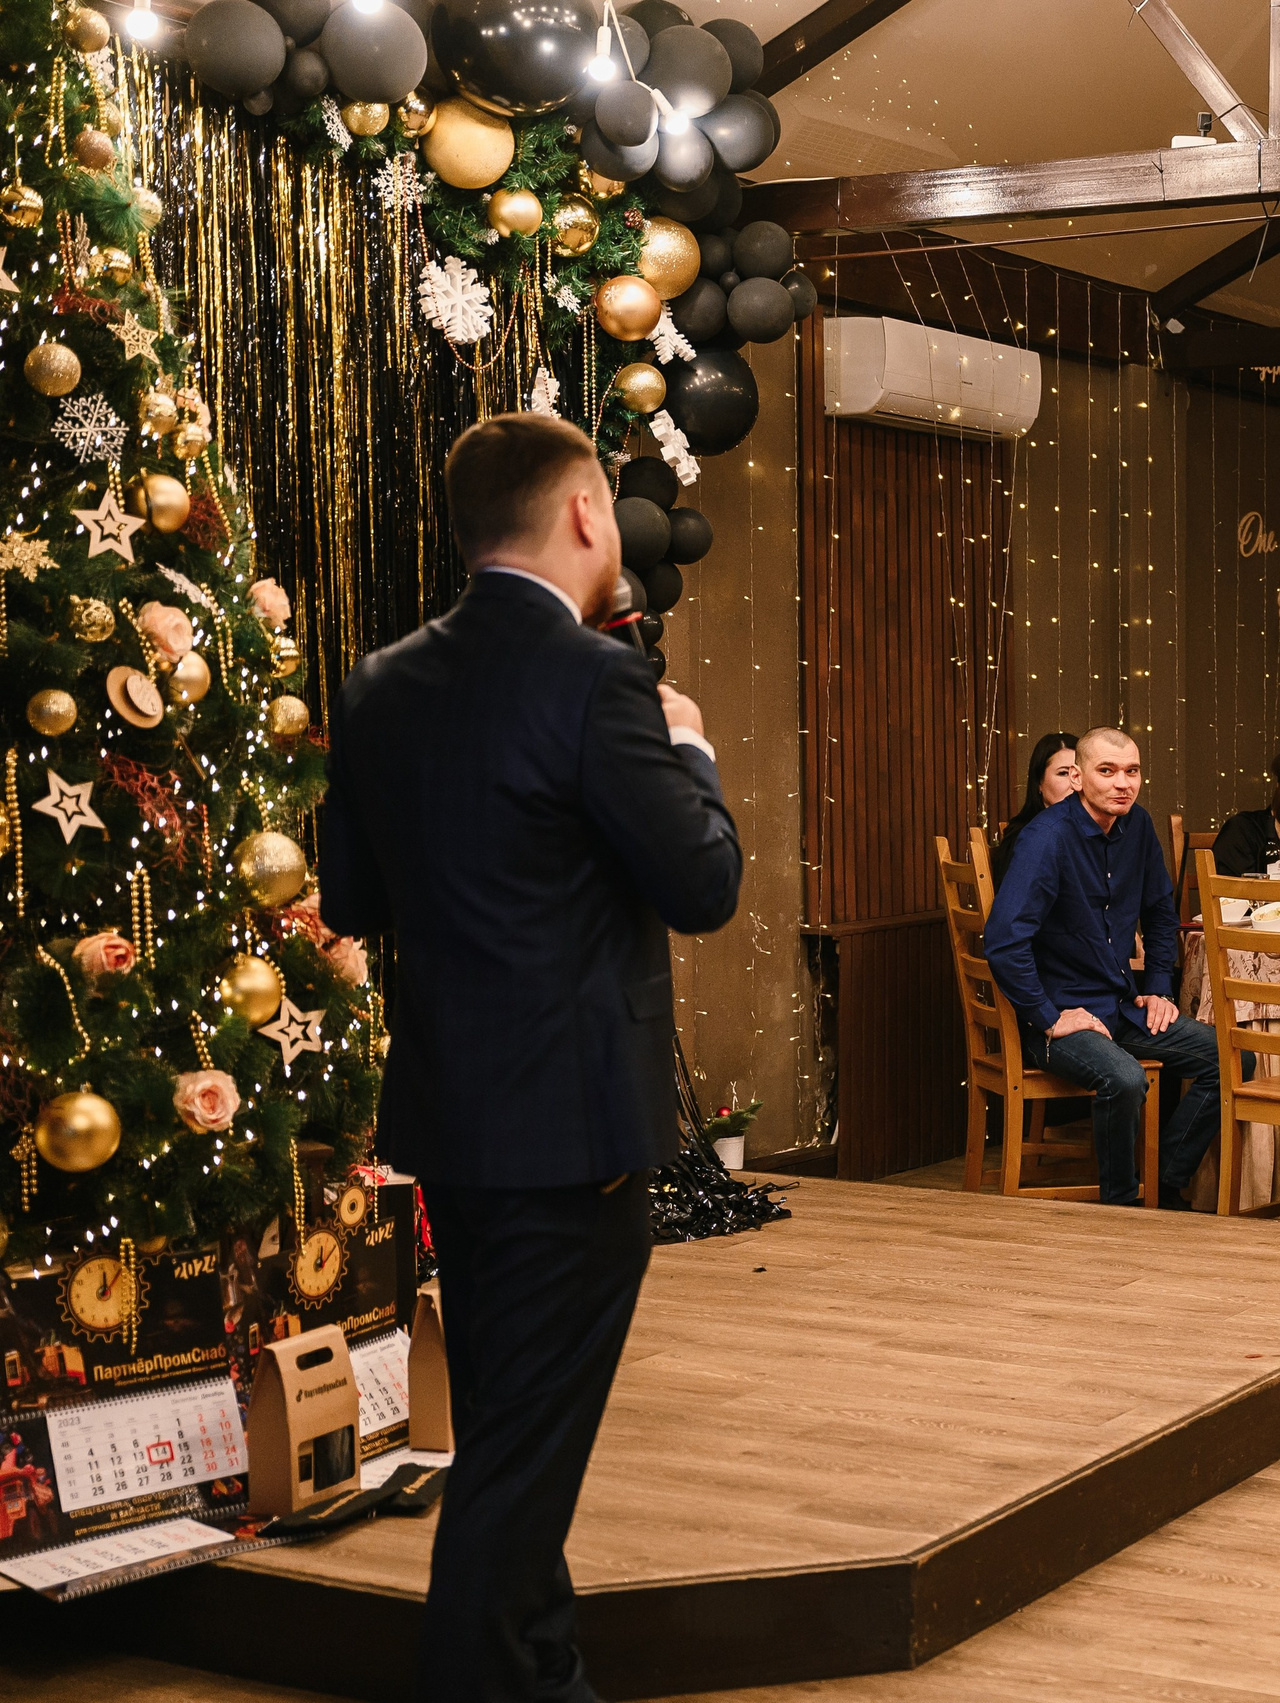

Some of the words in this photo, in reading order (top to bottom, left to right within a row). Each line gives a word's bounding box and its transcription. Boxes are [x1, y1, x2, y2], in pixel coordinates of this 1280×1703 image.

[1238, 511, 1278, 558] One
[93, 1343, 227, 1381] ПартнёрПромСнаб
[384, 1396, 395, 1405] 22
[88, 1448, 94, 1457] 4
[111, 1444, 117, 1453] 5
[219, 1421, 231, 1430] 10
[176, 1418, 181, 1427] 1
[87, 1461, 99, 1471] 11
[111, 1456, 122, 1466] 12
[134, 1451, 145, 1461] 13
[155, 1447, 167, 1457] 14
[178, 1443, 190, 1452] 15
[222, 1433, 233, 1443] 17
[90, 1474, 102, 1483] 18
[113, 1469, 125, 1478] 19
[136, 1465, 148, 1474] 20
[180, 1455, 192, 1465] 22
[203, 1450, 214, 1460] 23
[92, 1486, 105, 1497] 25
[138, 1477, 149, 1487] 27
[160, 1472, 172, 1482] 28
[183, 1467, 195, 1477] 29
[205, 1462, 217, 1472] 30
[228, 1457, 239, 1467] 31
